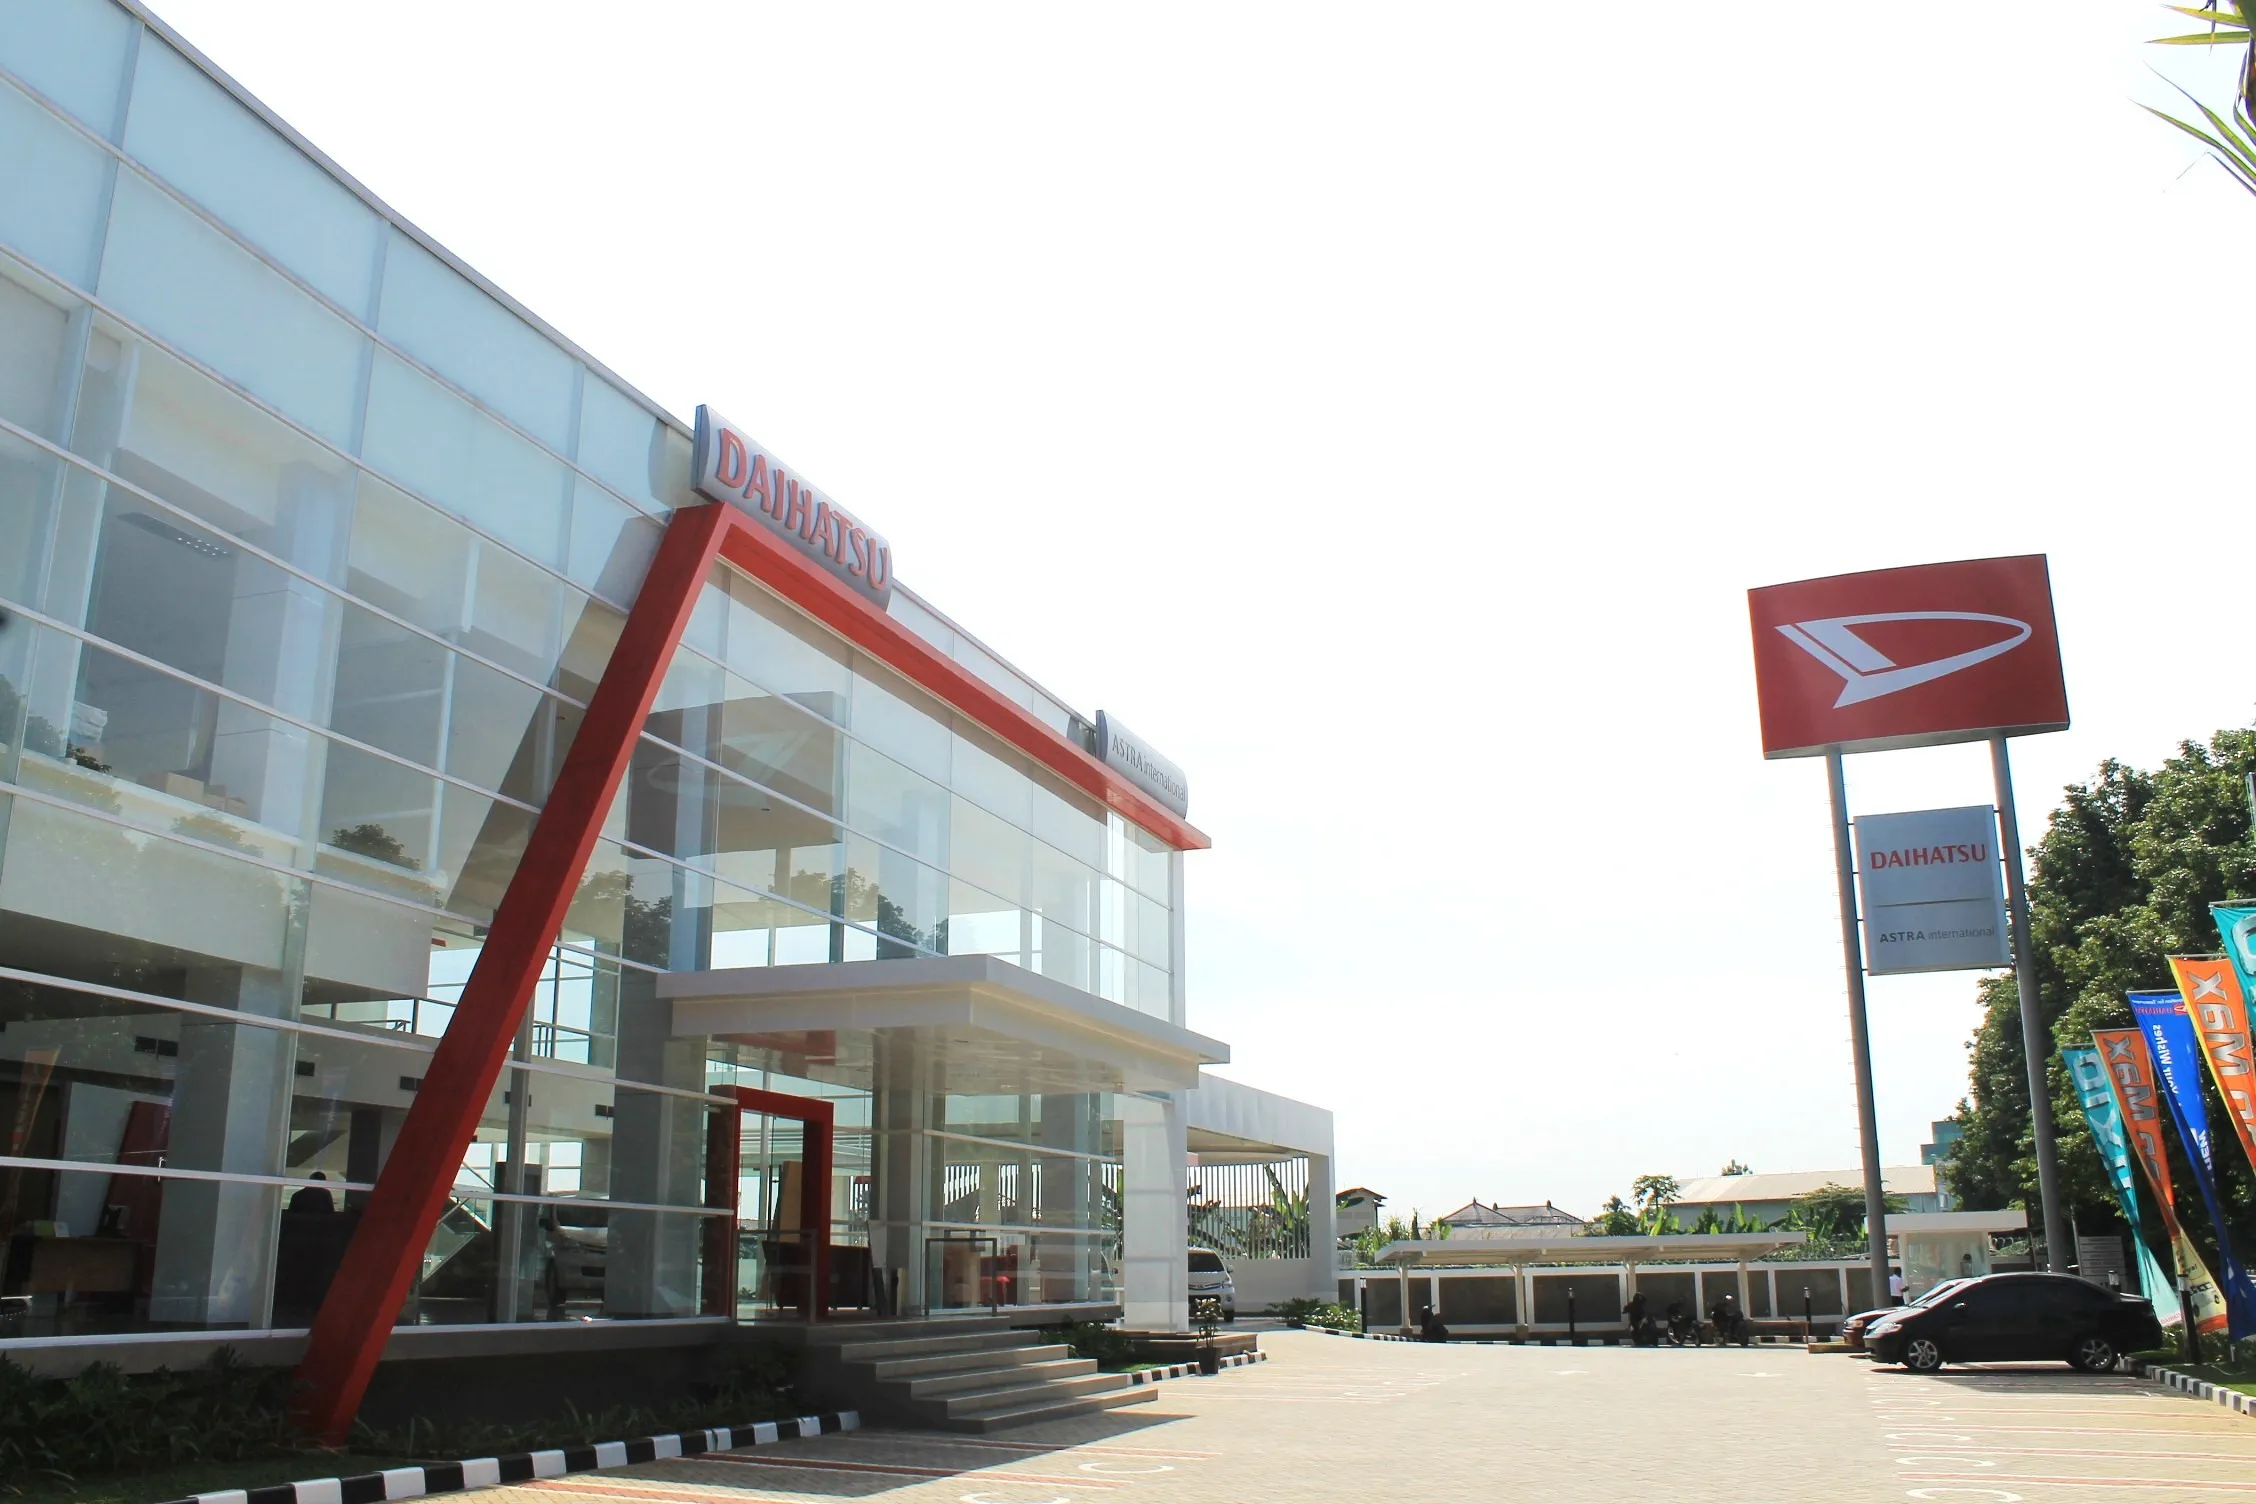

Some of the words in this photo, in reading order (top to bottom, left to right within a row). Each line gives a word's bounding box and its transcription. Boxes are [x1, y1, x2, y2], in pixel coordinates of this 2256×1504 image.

[716, 427, 889, 591] DAIHATSU
[1112, 734, 1143, 772] ASTRA
[1143, 755, 1186, 802] international
[1870, 843, 1986, 870] DAIHATSU
[1879, 930, 1925, 943] ASTRA
[1928, 926, 1995, 941] international
